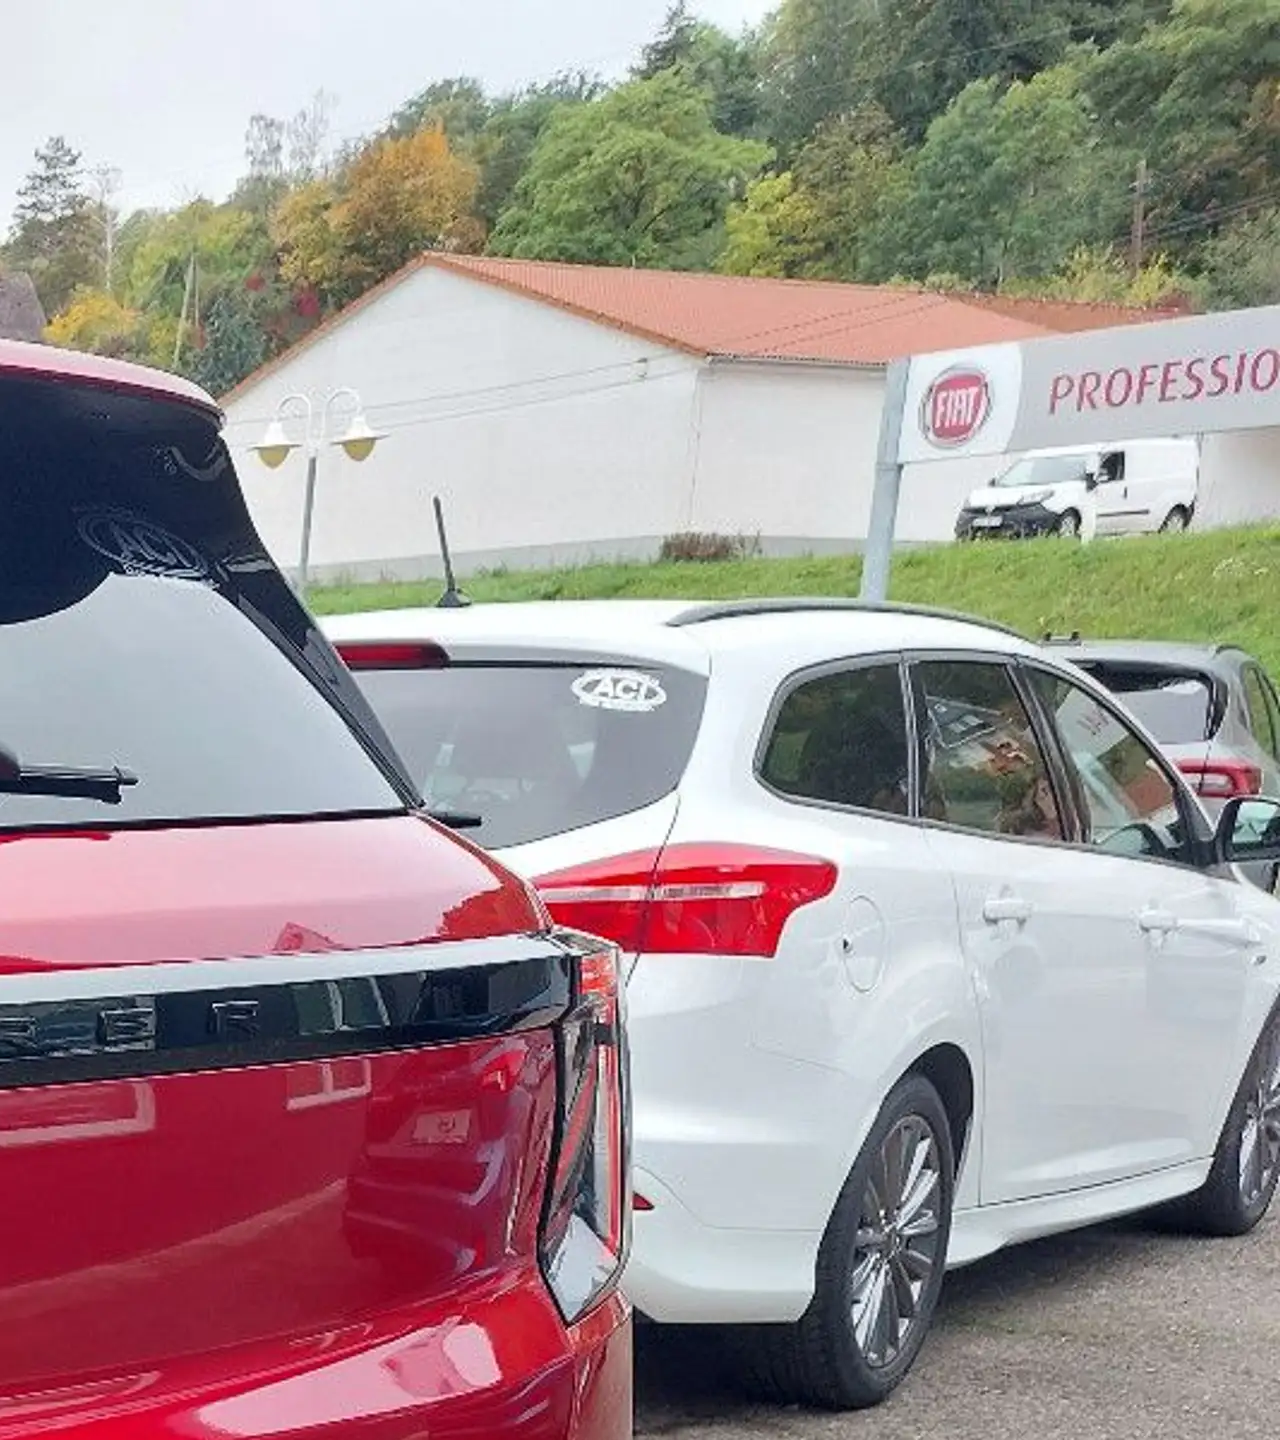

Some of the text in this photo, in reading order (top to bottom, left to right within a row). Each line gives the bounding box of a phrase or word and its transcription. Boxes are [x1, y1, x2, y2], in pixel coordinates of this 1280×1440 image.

[1048, 347, 1280, 416] PROFESSIO
[934, 386, 981, 430] FIAT
[593, 676, 649, 701] ACI
